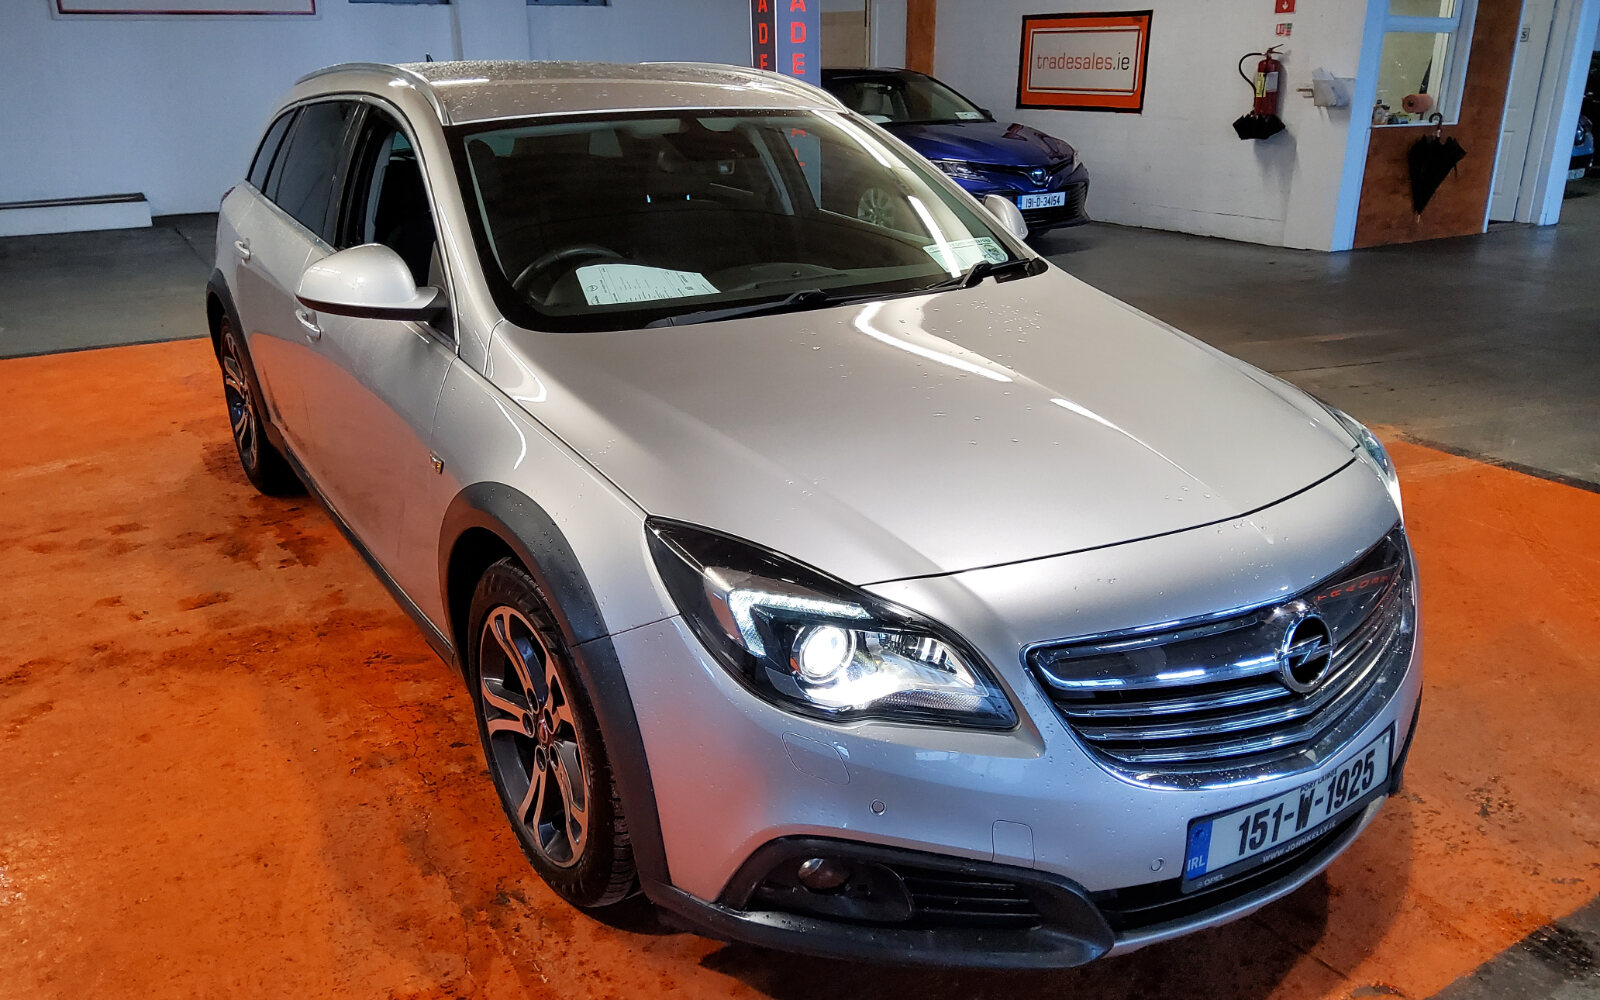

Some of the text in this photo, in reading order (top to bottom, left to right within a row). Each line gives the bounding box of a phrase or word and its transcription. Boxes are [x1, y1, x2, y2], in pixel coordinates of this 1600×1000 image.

[1037, 52, 1130, 71] tradesales.ie
[1238, 749, 1376, 856] 151-W-1925
[1187, 855, 1206, 872] IRL
